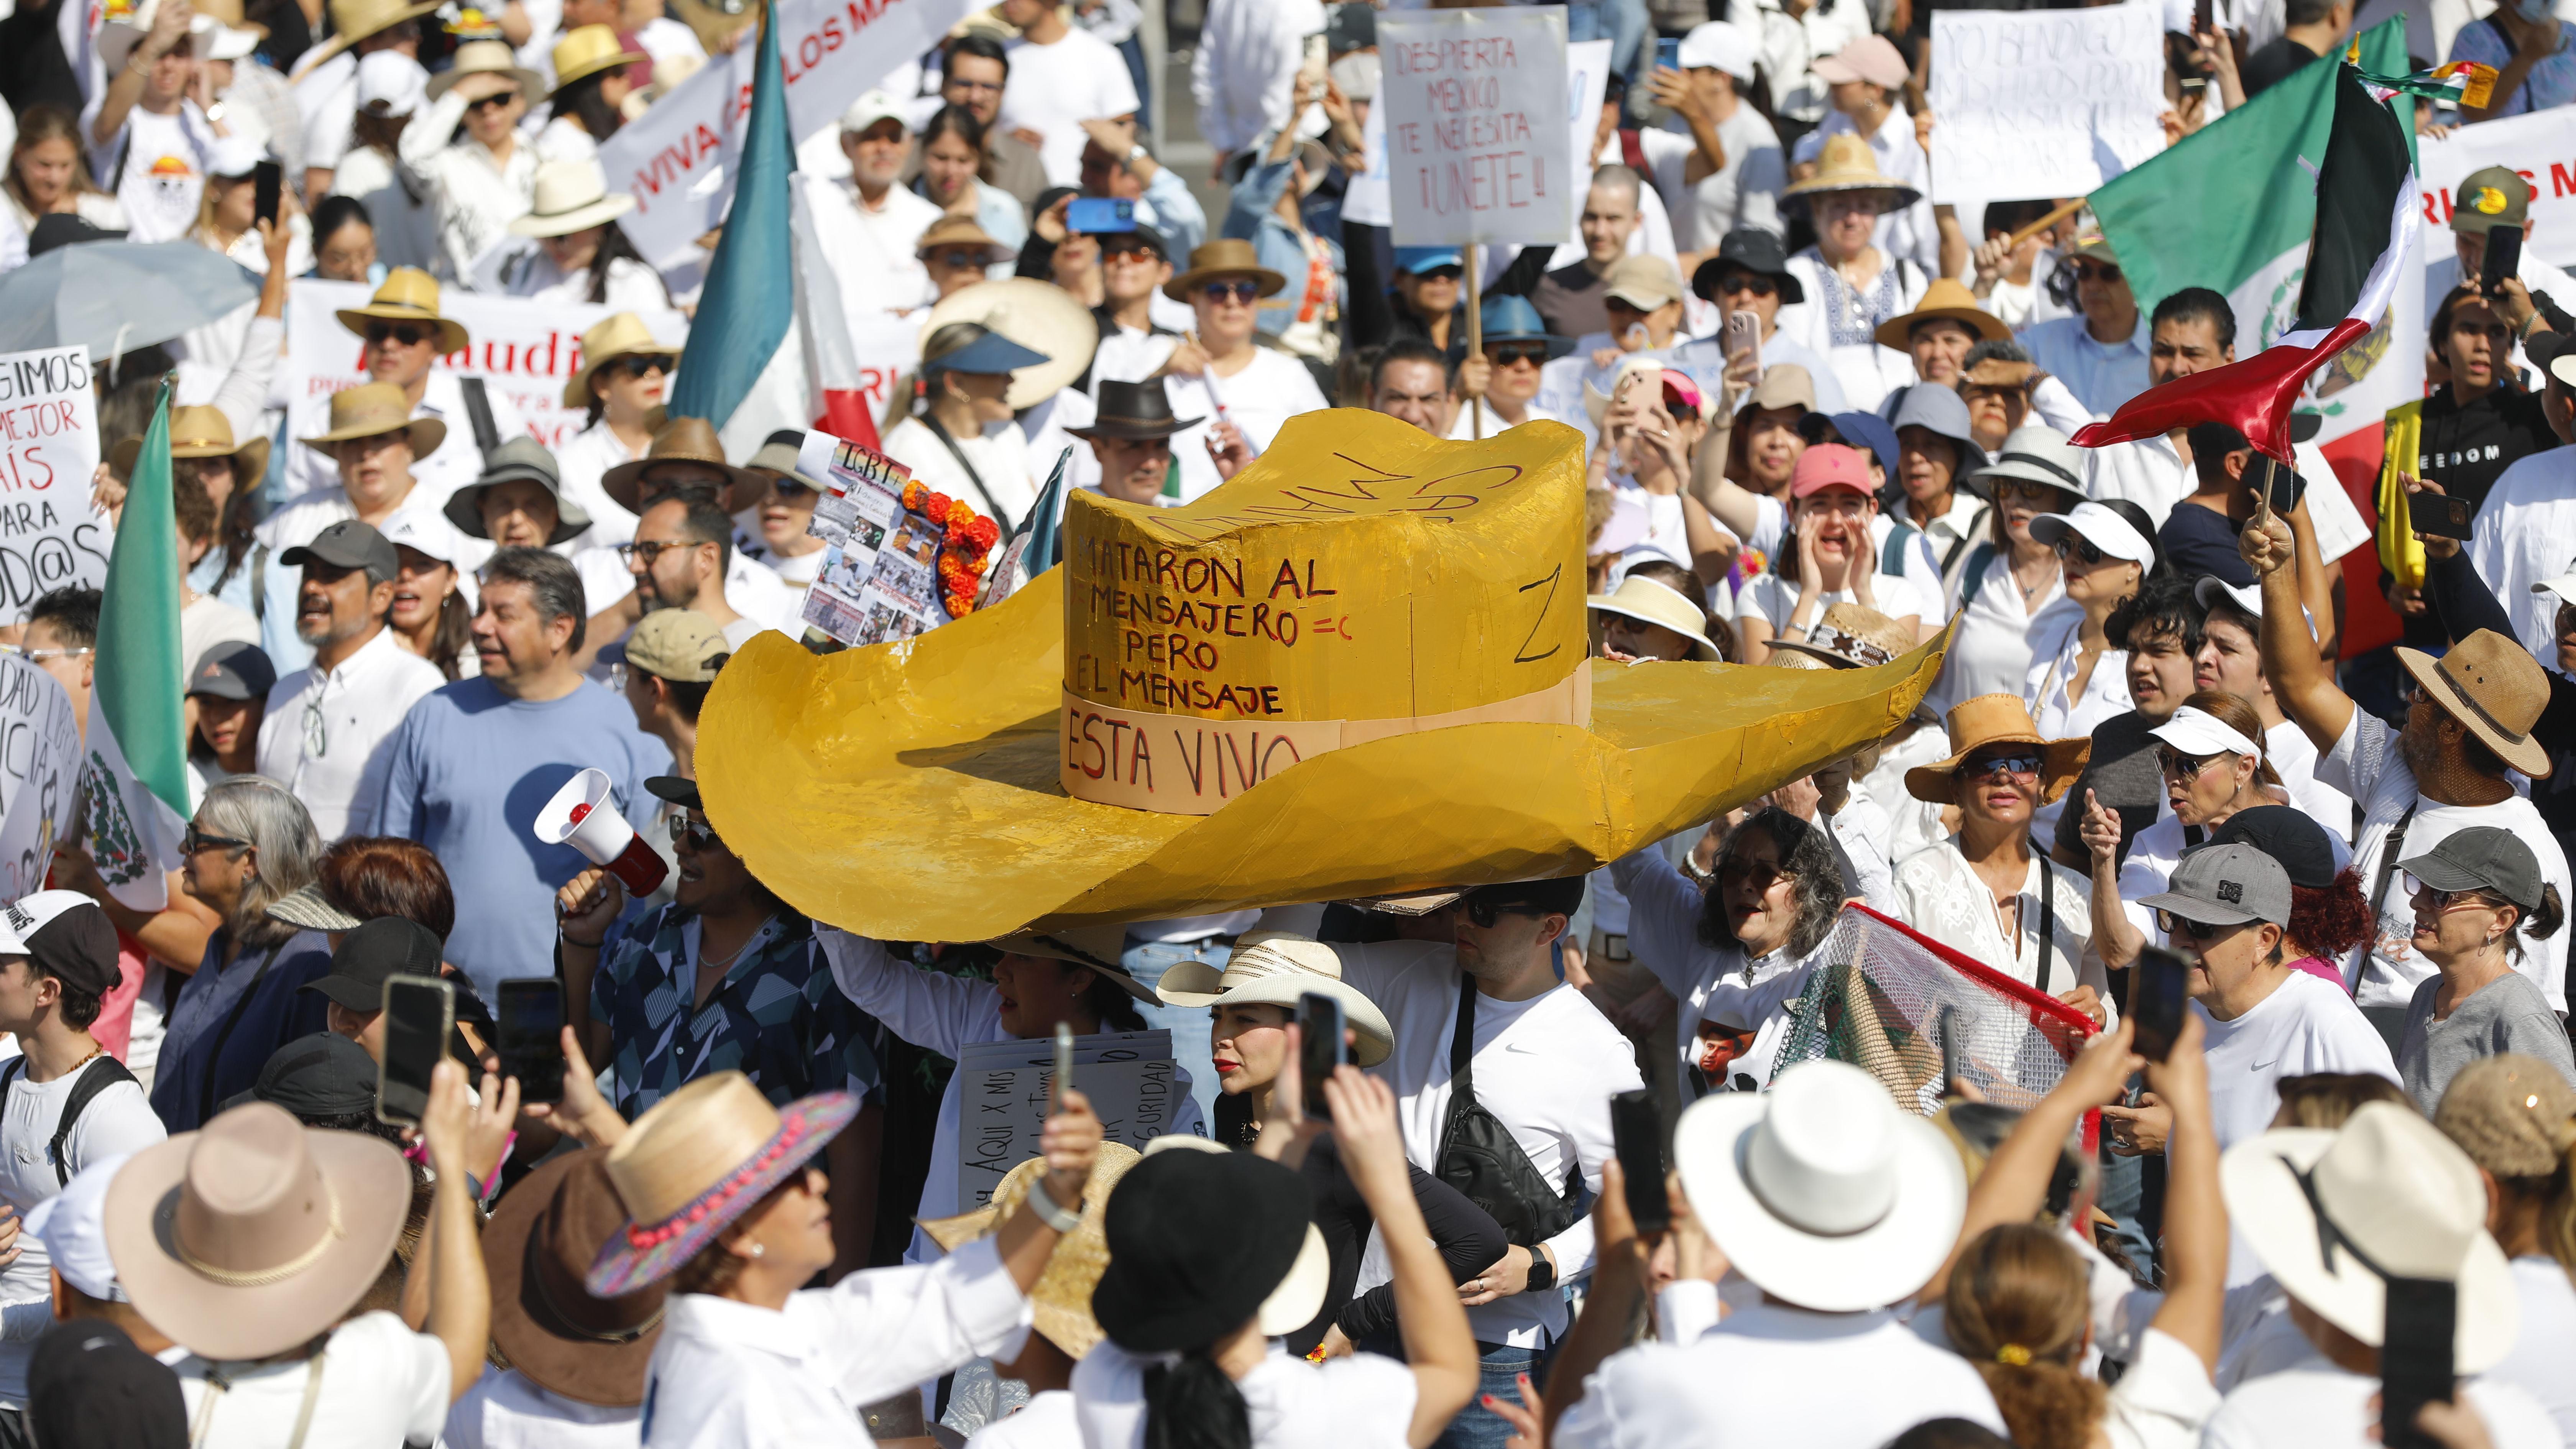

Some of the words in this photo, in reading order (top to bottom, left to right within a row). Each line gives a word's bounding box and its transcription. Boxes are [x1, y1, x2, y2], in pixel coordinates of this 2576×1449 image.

[1394, 36, 1517, 76] DESPIERTA
[1396, 121, 1423, 155] TE
[1433, 111, 1533, 154] NECESITA
[0, 501, 59, 537] ARA
[0, 524, 109, 609] D@S
[1078, 537, 1245, 598] MATARON
[1267, 558, 1338, 600] AL
[1091, 585, 1300, 648] MENSAJERO
[1126, 630, 1219, 672] PERO
[1077, 654, 1108, 693] EL
[1119, 668, 1284, 716] MENSAJE
[1068, 706, 1154, 794] ESTA
[981, 1102, 1013, 1114] X
[982, 1071, 1016, 1095] MIS
[1132, 1062, 1171, 1151] GURIDAD
